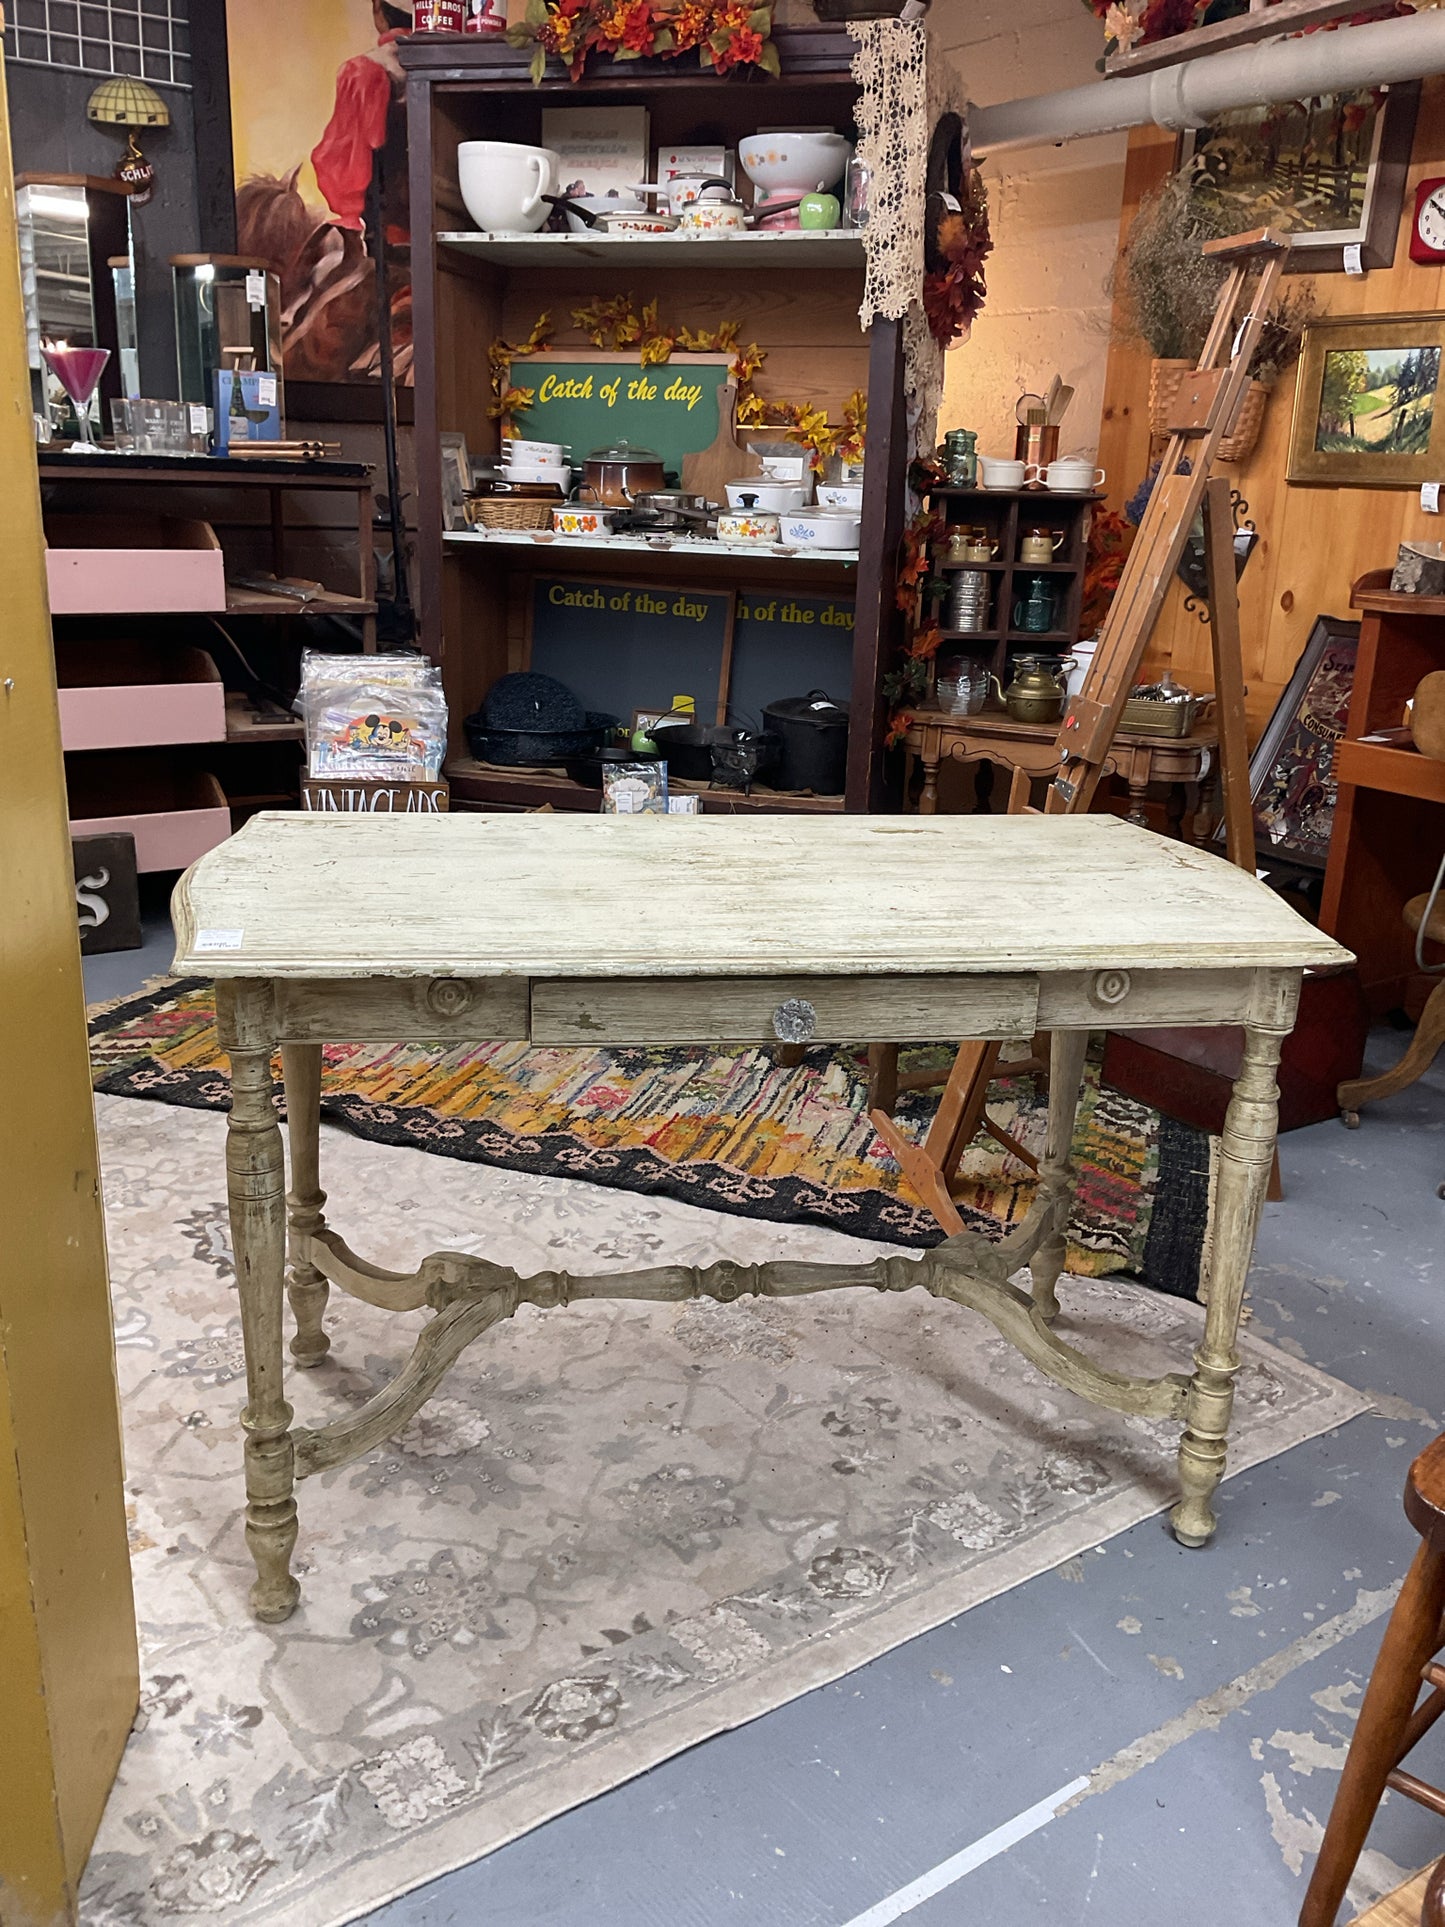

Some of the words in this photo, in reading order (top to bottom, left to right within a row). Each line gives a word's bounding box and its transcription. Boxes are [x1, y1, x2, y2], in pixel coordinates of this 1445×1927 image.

[441, 1, 461, 13] BROS
[421, 15, 453, 26] COFFEE
[120, 164, 154, 181] SCHLIT
[539, 374, 594, 403] Catch
[600, 377, 622, 407] of
[627, 376, 658, 400] the
[664, 376, 703, 411] day
[549, 585, 605, 608] Catch
[610, 592, 632, 611] of
[634, 594, 668, 615] the
[672, 597, 708, 621] day
[754, 602, 777, 621] of
[781, 603, 815, 623] the
[820, 606, 855, 629] day
